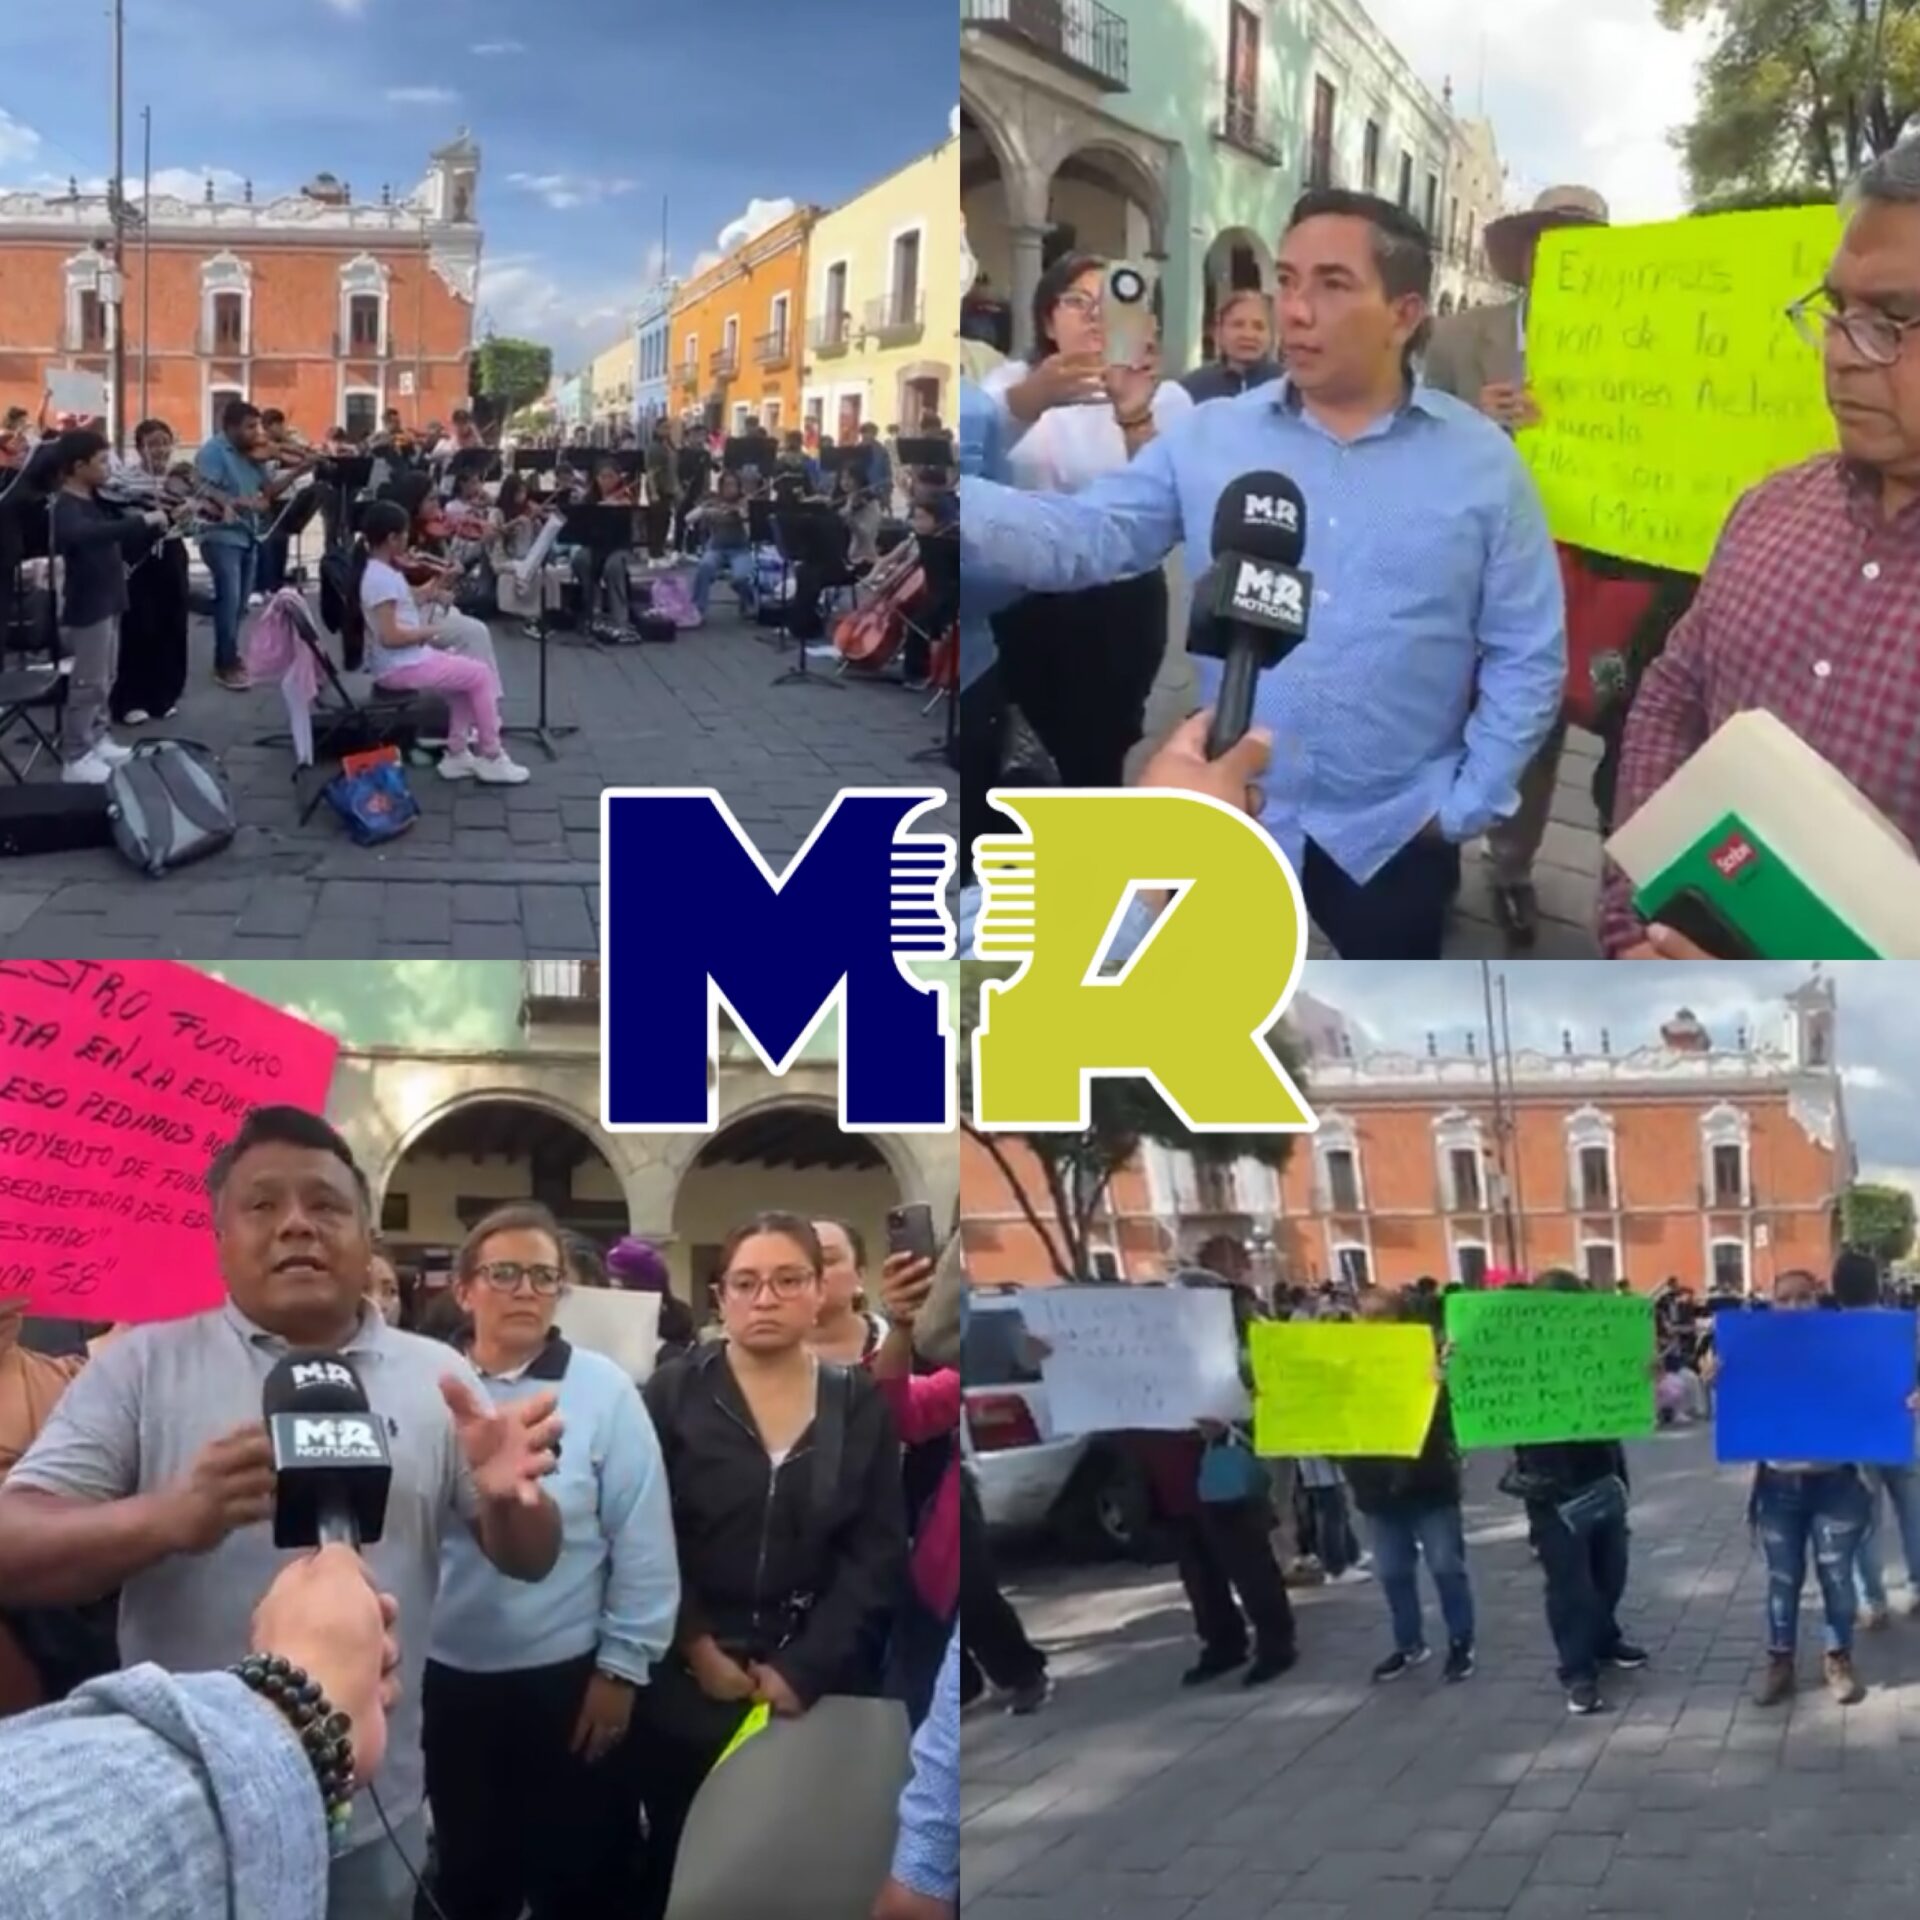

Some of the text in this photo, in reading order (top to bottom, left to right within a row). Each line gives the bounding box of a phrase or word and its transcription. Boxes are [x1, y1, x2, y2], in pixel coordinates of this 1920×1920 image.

[1245, 493, 1298, 524] MR
[1236, 561, 1303, 612] MR
[1232, 594, 1304, 625] NOTICIAS
[169, 1011, 282, 1078] FUTURO
[131, 1061, 176, 1091] LA
[0, 1076, 68, 1110] ESO
[76, 1091, 195, 1145] PEDIMOS
[112, 1156, 153, 1179] DE
[295, 1419, 378, 1448] MR
[296, 1446, 382, 1457] NOTICIAS
